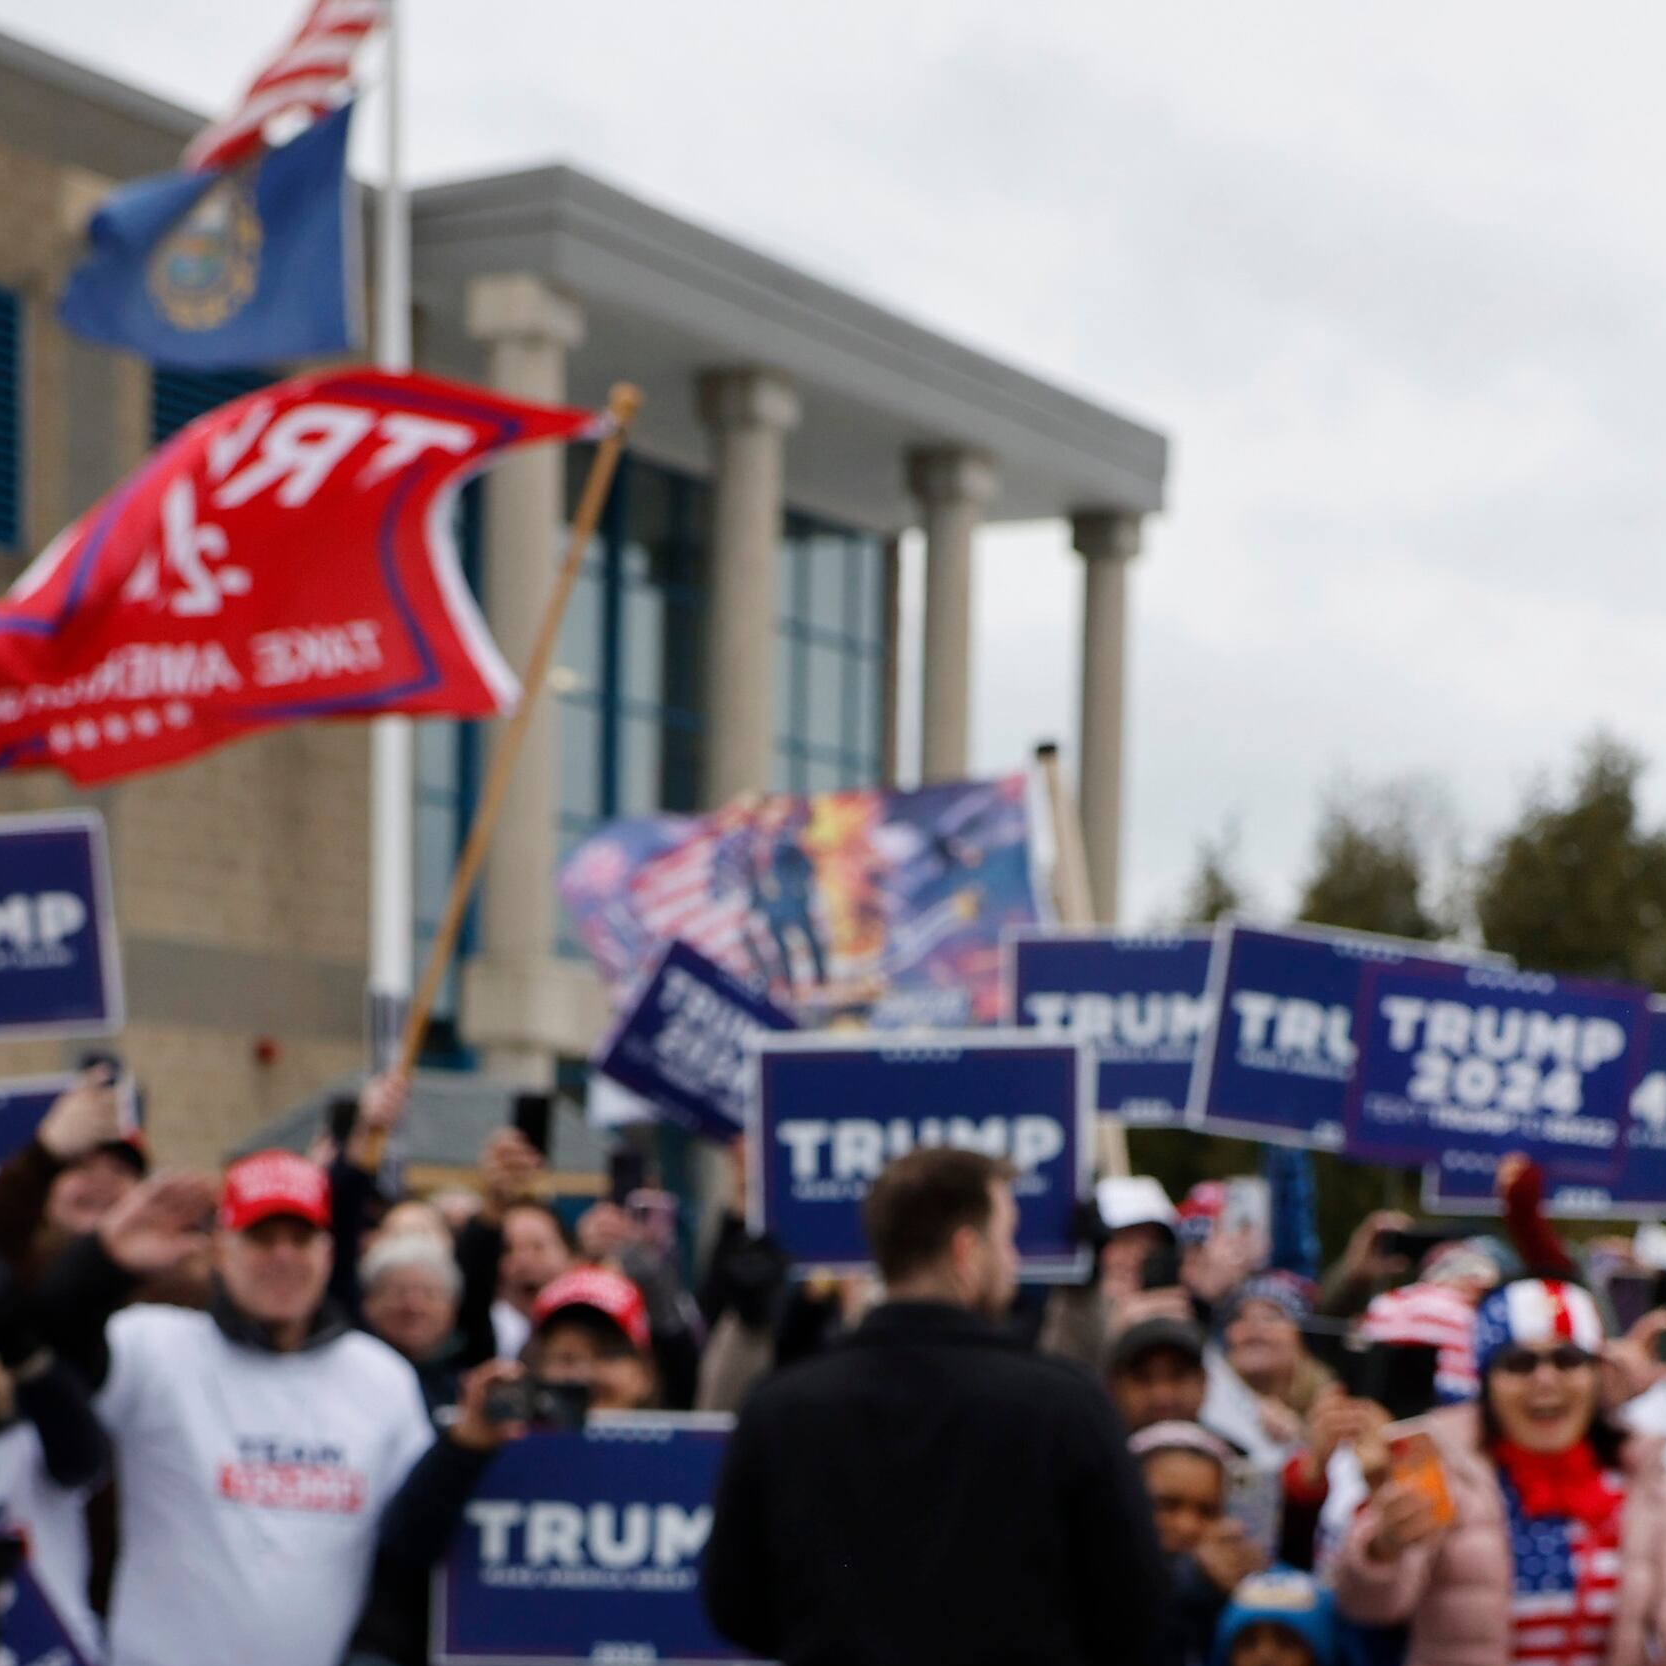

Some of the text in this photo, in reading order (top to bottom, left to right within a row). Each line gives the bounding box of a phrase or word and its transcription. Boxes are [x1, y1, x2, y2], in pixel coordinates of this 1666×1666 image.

[1025, 990, 1211, 1046] TRUM
[1380, 994, 1627, 1072] TRUMP
[1406, 1050, 1583, 1118] 2024
[465, 1500, 715, 1571] TRUM
